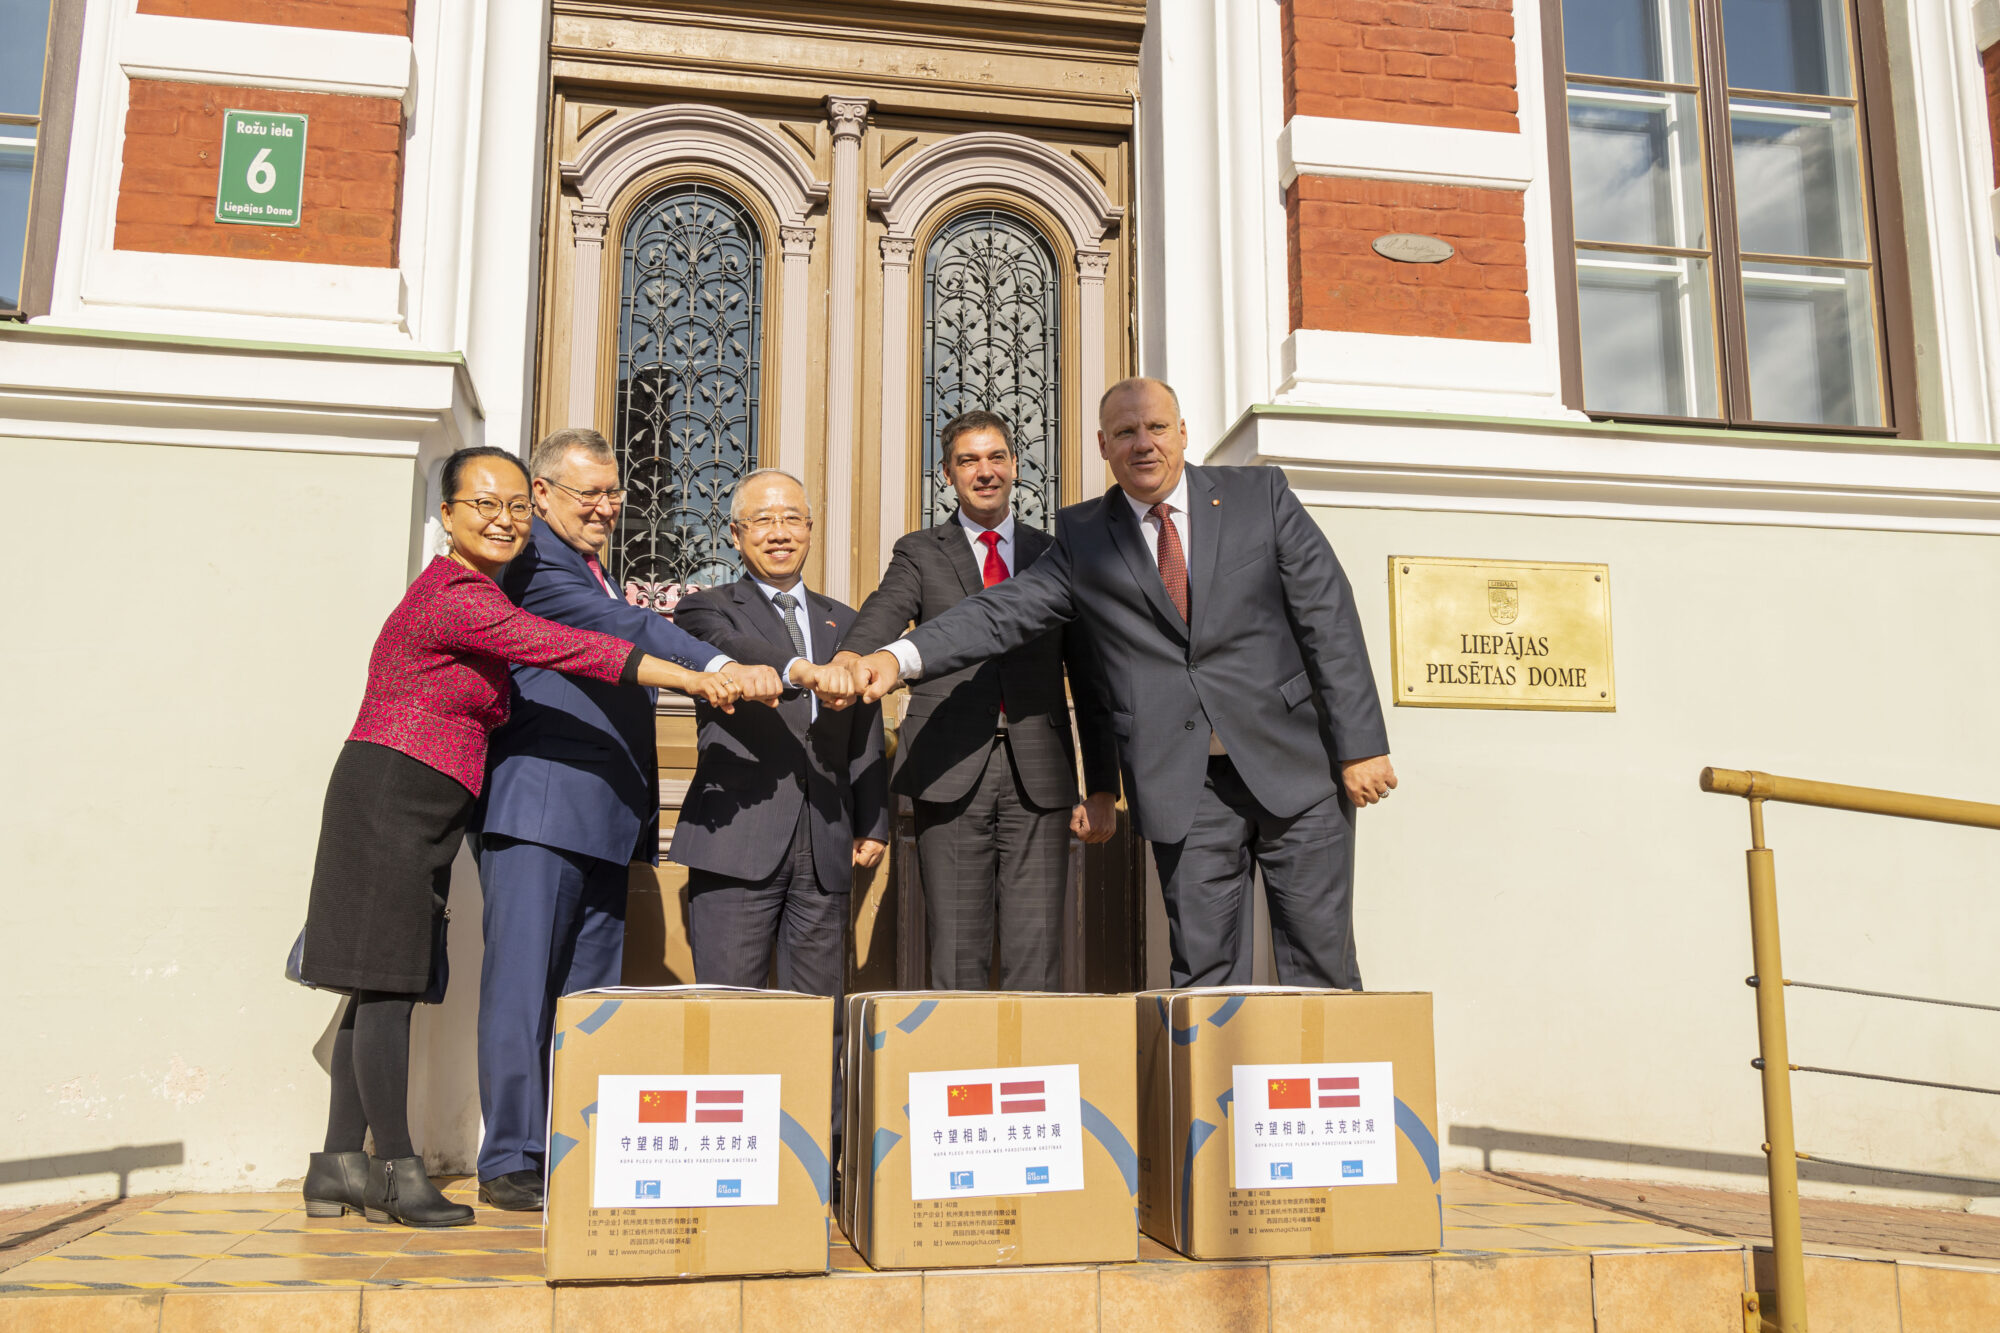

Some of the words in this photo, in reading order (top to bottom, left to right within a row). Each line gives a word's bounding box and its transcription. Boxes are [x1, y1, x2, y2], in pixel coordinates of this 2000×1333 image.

[236, 120, 267, 136] Rožu
[271, 122, 293, 137] iela
[246, 148, 276, 194] 6
[224, 202, 263, 216] Liepājas
[266, 205, 293, 216] Dome
[1460, 632, 1549, 660] LIEPĀJAS
[1426, 661, 1516, 686] PILSĒTAS
[1528, 666, 1587, 688] DOME
